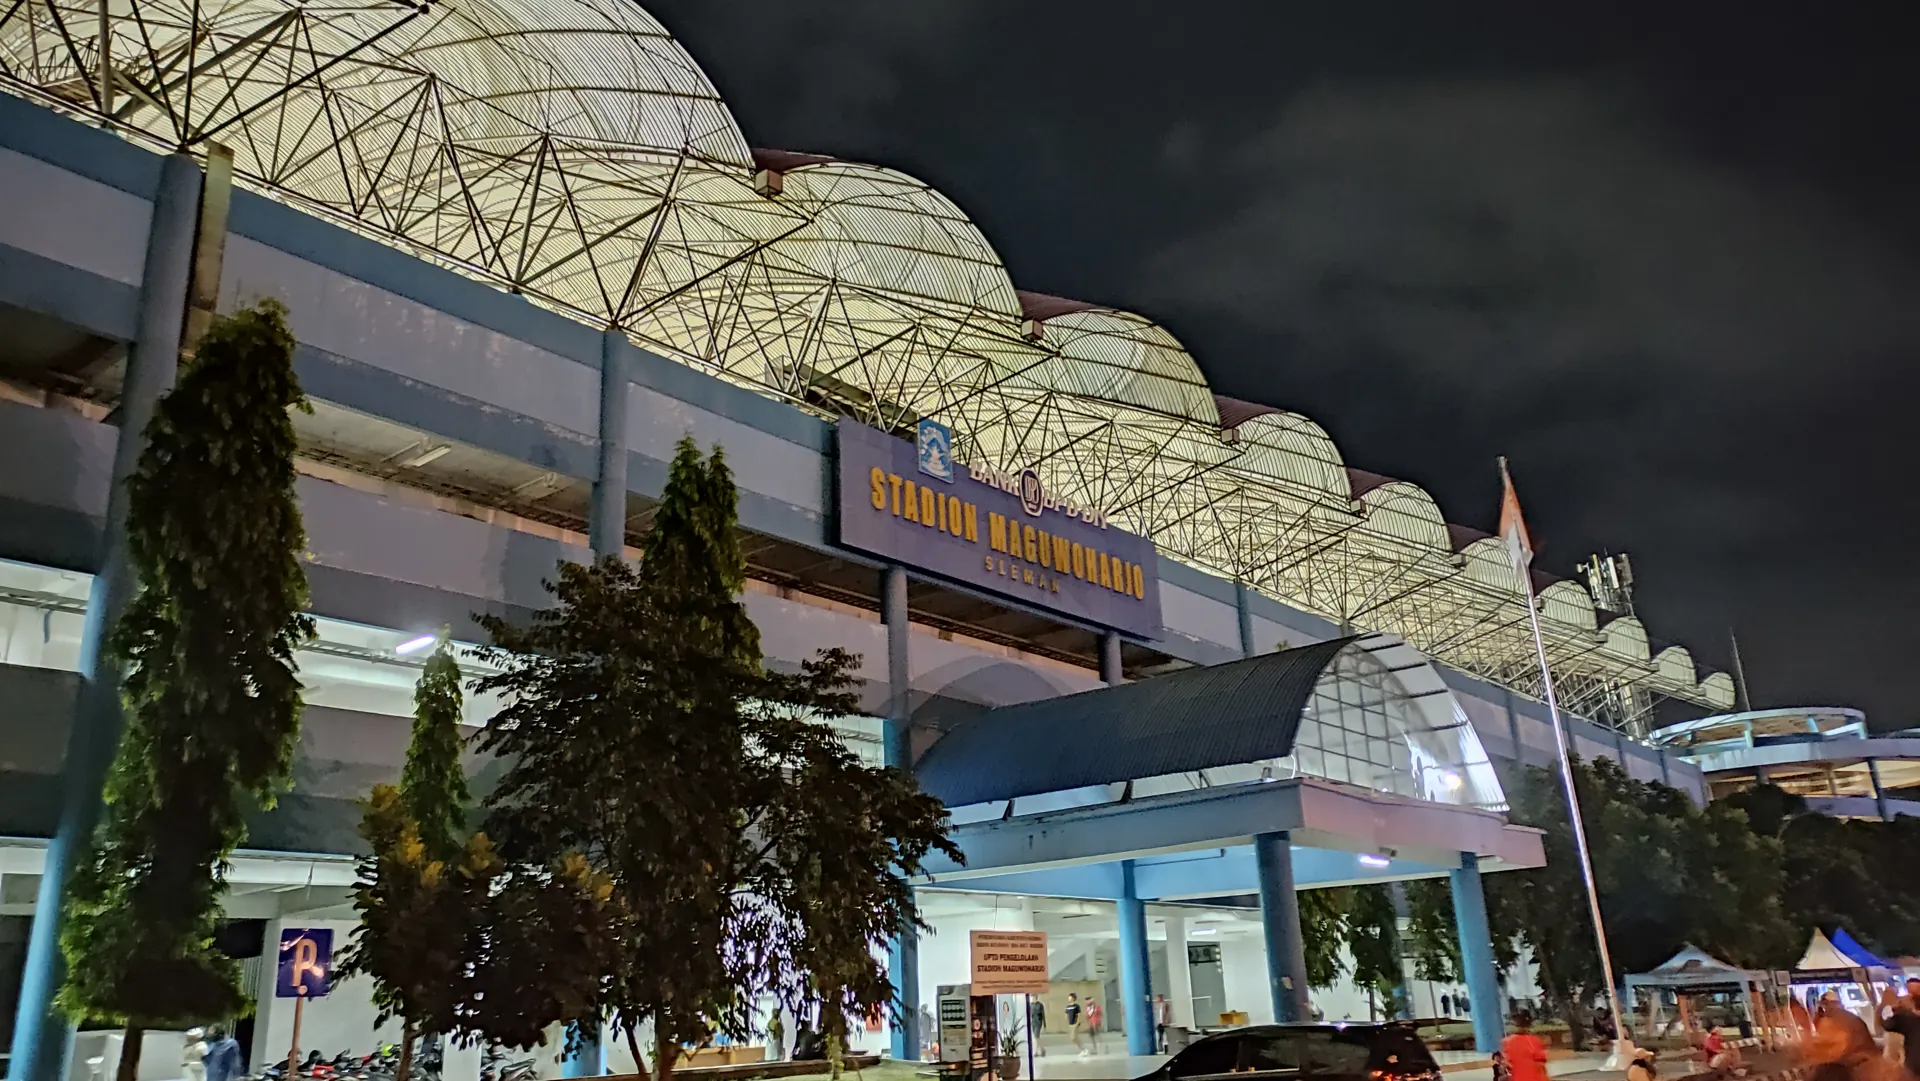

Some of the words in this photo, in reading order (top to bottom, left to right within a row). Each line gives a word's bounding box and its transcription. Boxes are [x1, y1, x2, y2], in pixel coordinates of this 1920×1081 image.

[969, 460, 1020, 496] BANK
[870, 466, 978, 543] STADION
[989, 511, 1145, 600] MAGUWOHARJO
[984, 555, 1060, 593] SLEMAN
